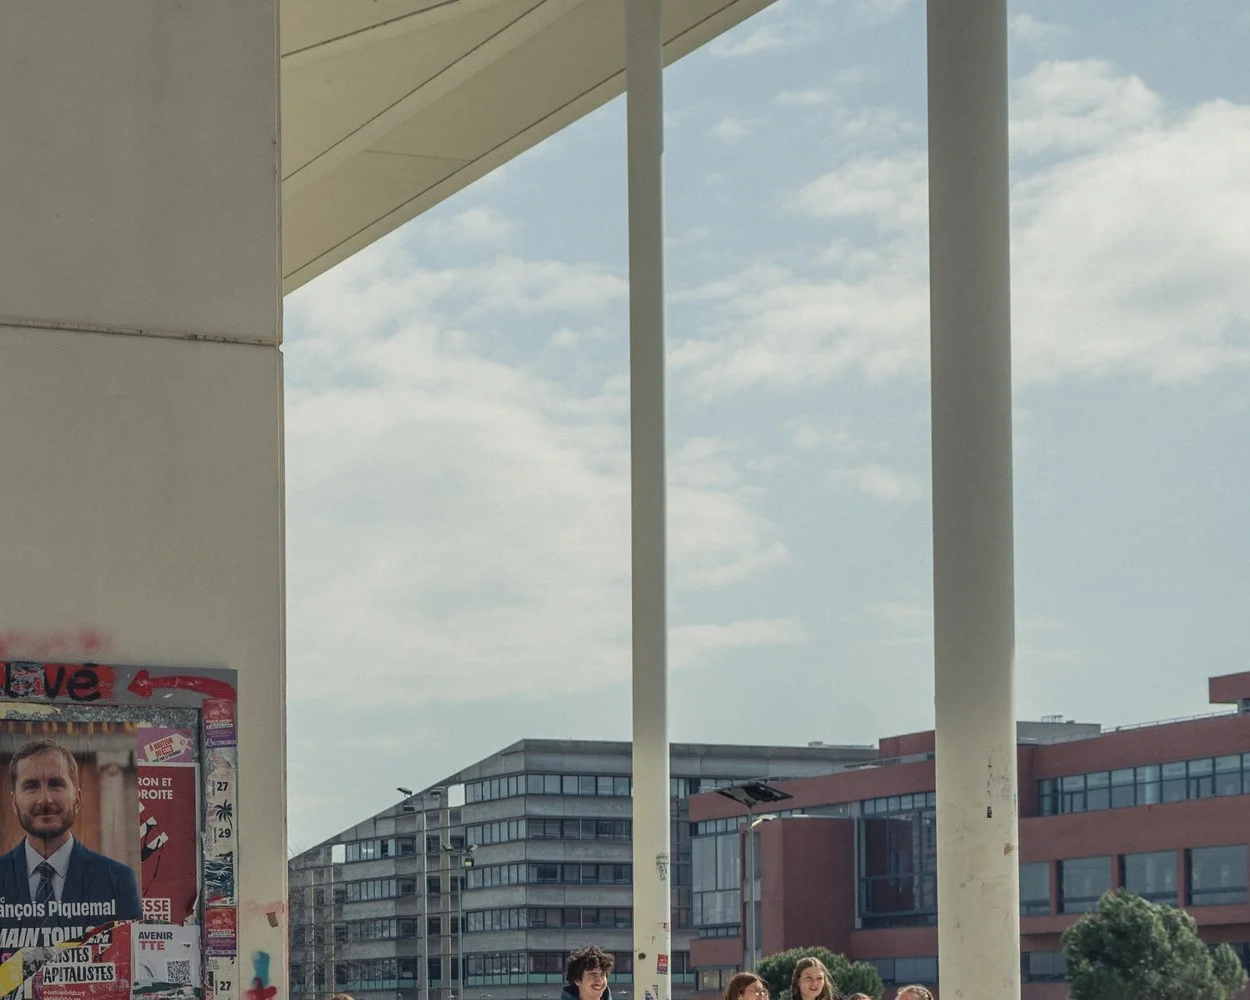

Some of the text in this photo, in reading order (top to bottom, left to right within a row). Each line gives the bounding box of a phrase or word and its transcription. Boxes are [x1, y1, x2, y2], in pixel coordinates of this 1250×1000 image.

[162, 777, 172, 786] ET
[217, 781, 228, 792] 27
[218, 828, 231, 839] 29
[49, 899, 116, 918] Piquemal
[138, 931, 173, 940] AVENIR
[220, 980, 230, 991] 27
